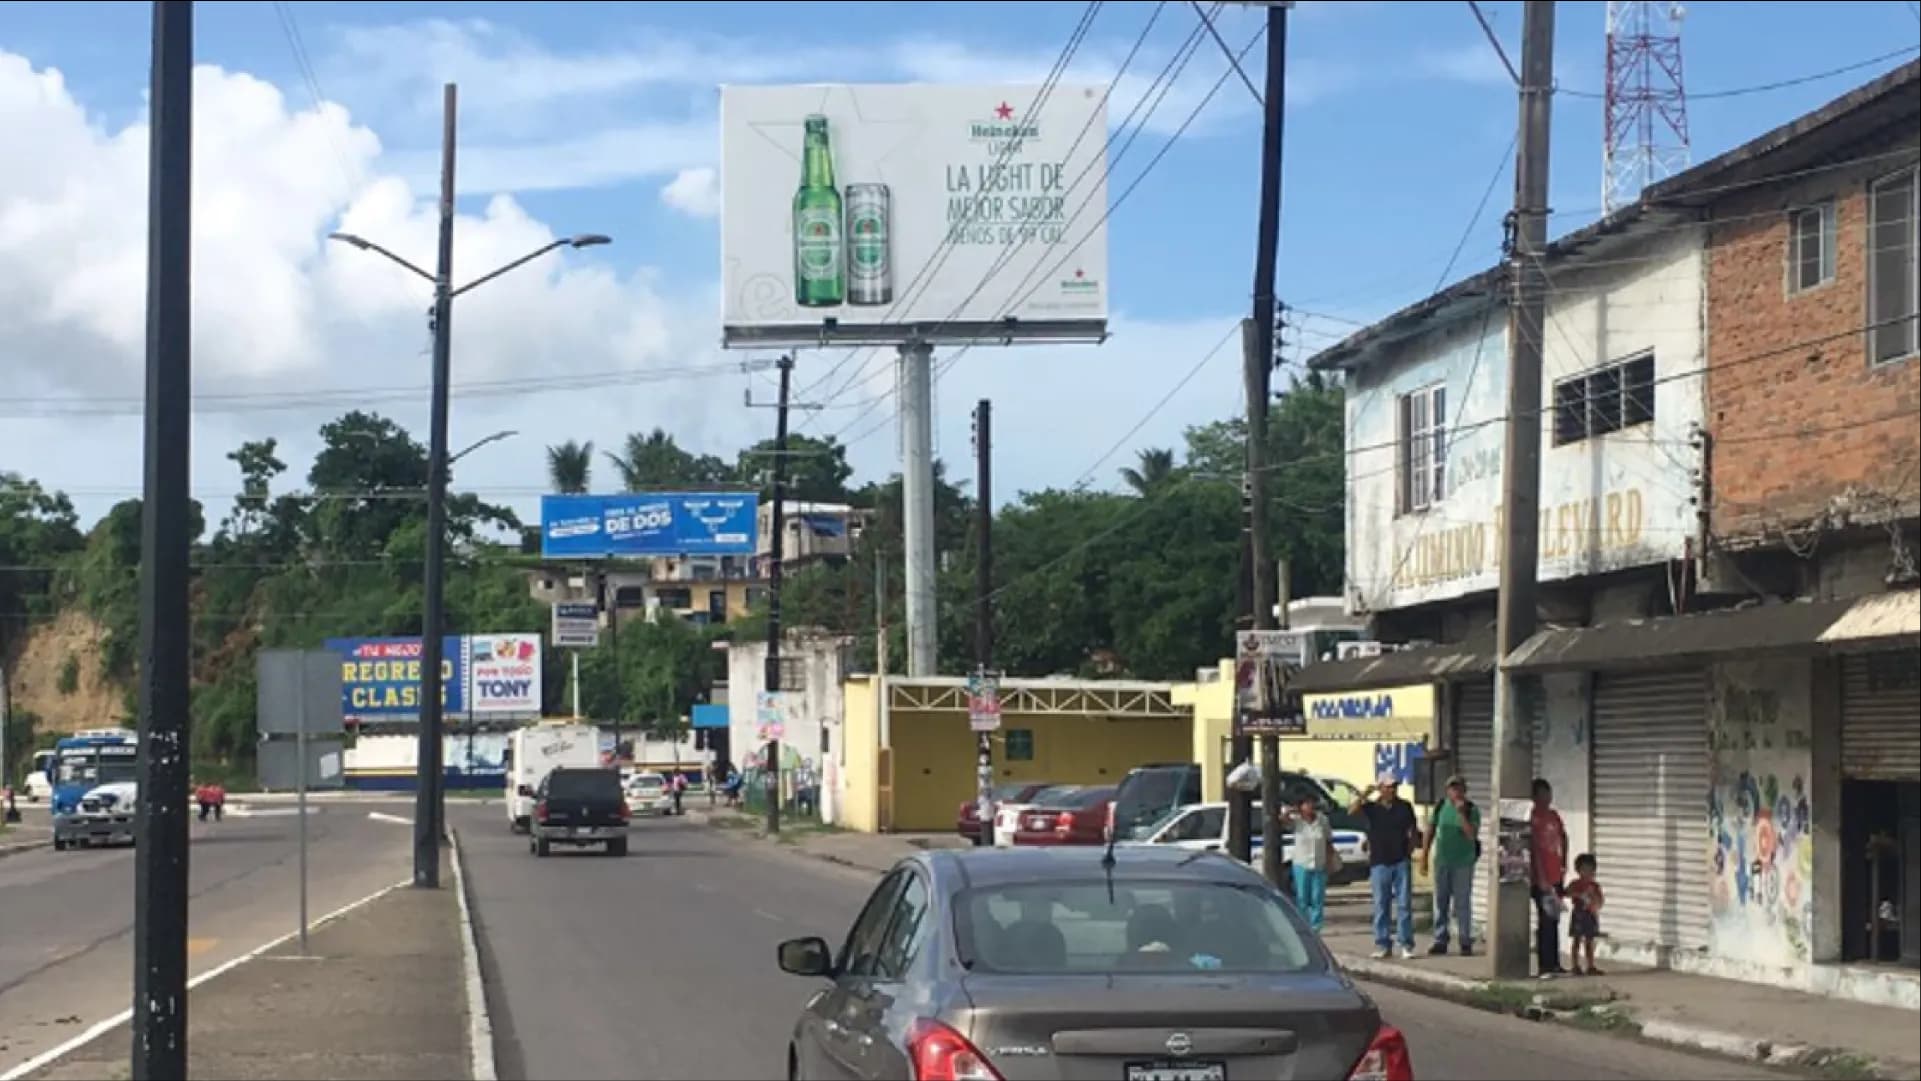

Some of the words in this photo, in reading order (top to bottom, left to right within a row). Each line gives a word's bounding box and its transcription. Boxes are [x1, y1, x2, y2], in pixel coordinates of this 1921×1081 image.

[946, 165, 971, 193] LA
[1040, 163, 1065, 192] DE
[605, 516, 630, 535] DE
[632, 510, 673, 530] DOS
[342, 659, 454, 682] REGREO
[477, 679, 531, 698] TONY
